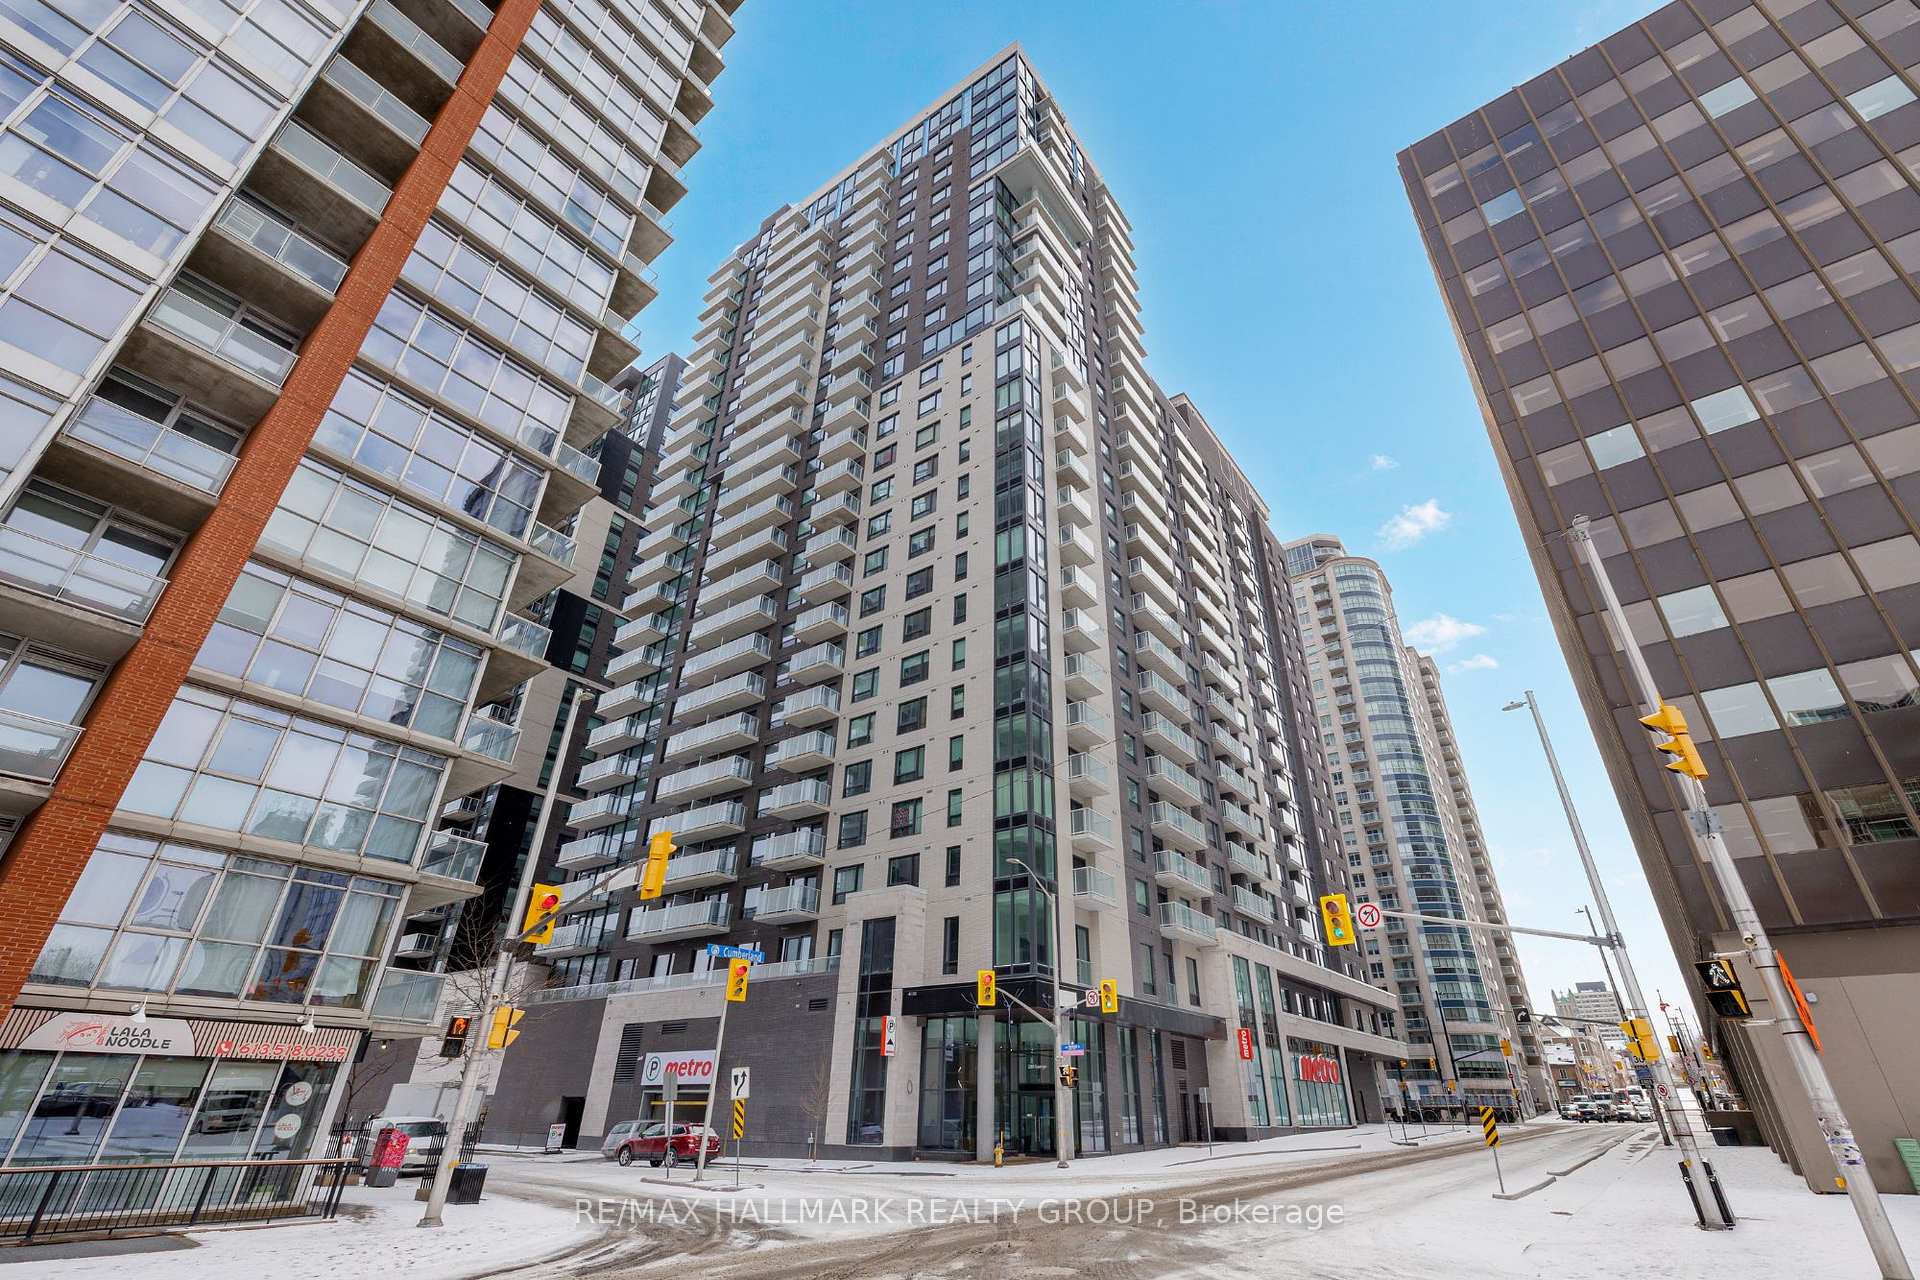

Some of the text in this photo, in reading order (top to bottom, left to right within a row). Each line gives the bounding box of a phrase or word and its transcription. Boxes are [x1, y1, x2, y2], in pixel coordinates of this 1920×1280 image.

[110, 1026, 152, 1038] LALA
[105, 1037, 172, 1049] NOODLE
[239, 1042, 347, 1058] 613.518.0239
[1240, 1029, 1250, 1058] metro
[664, 1058, 713, 1077] metro
[1299, 1053, 1339, 1085] metro
